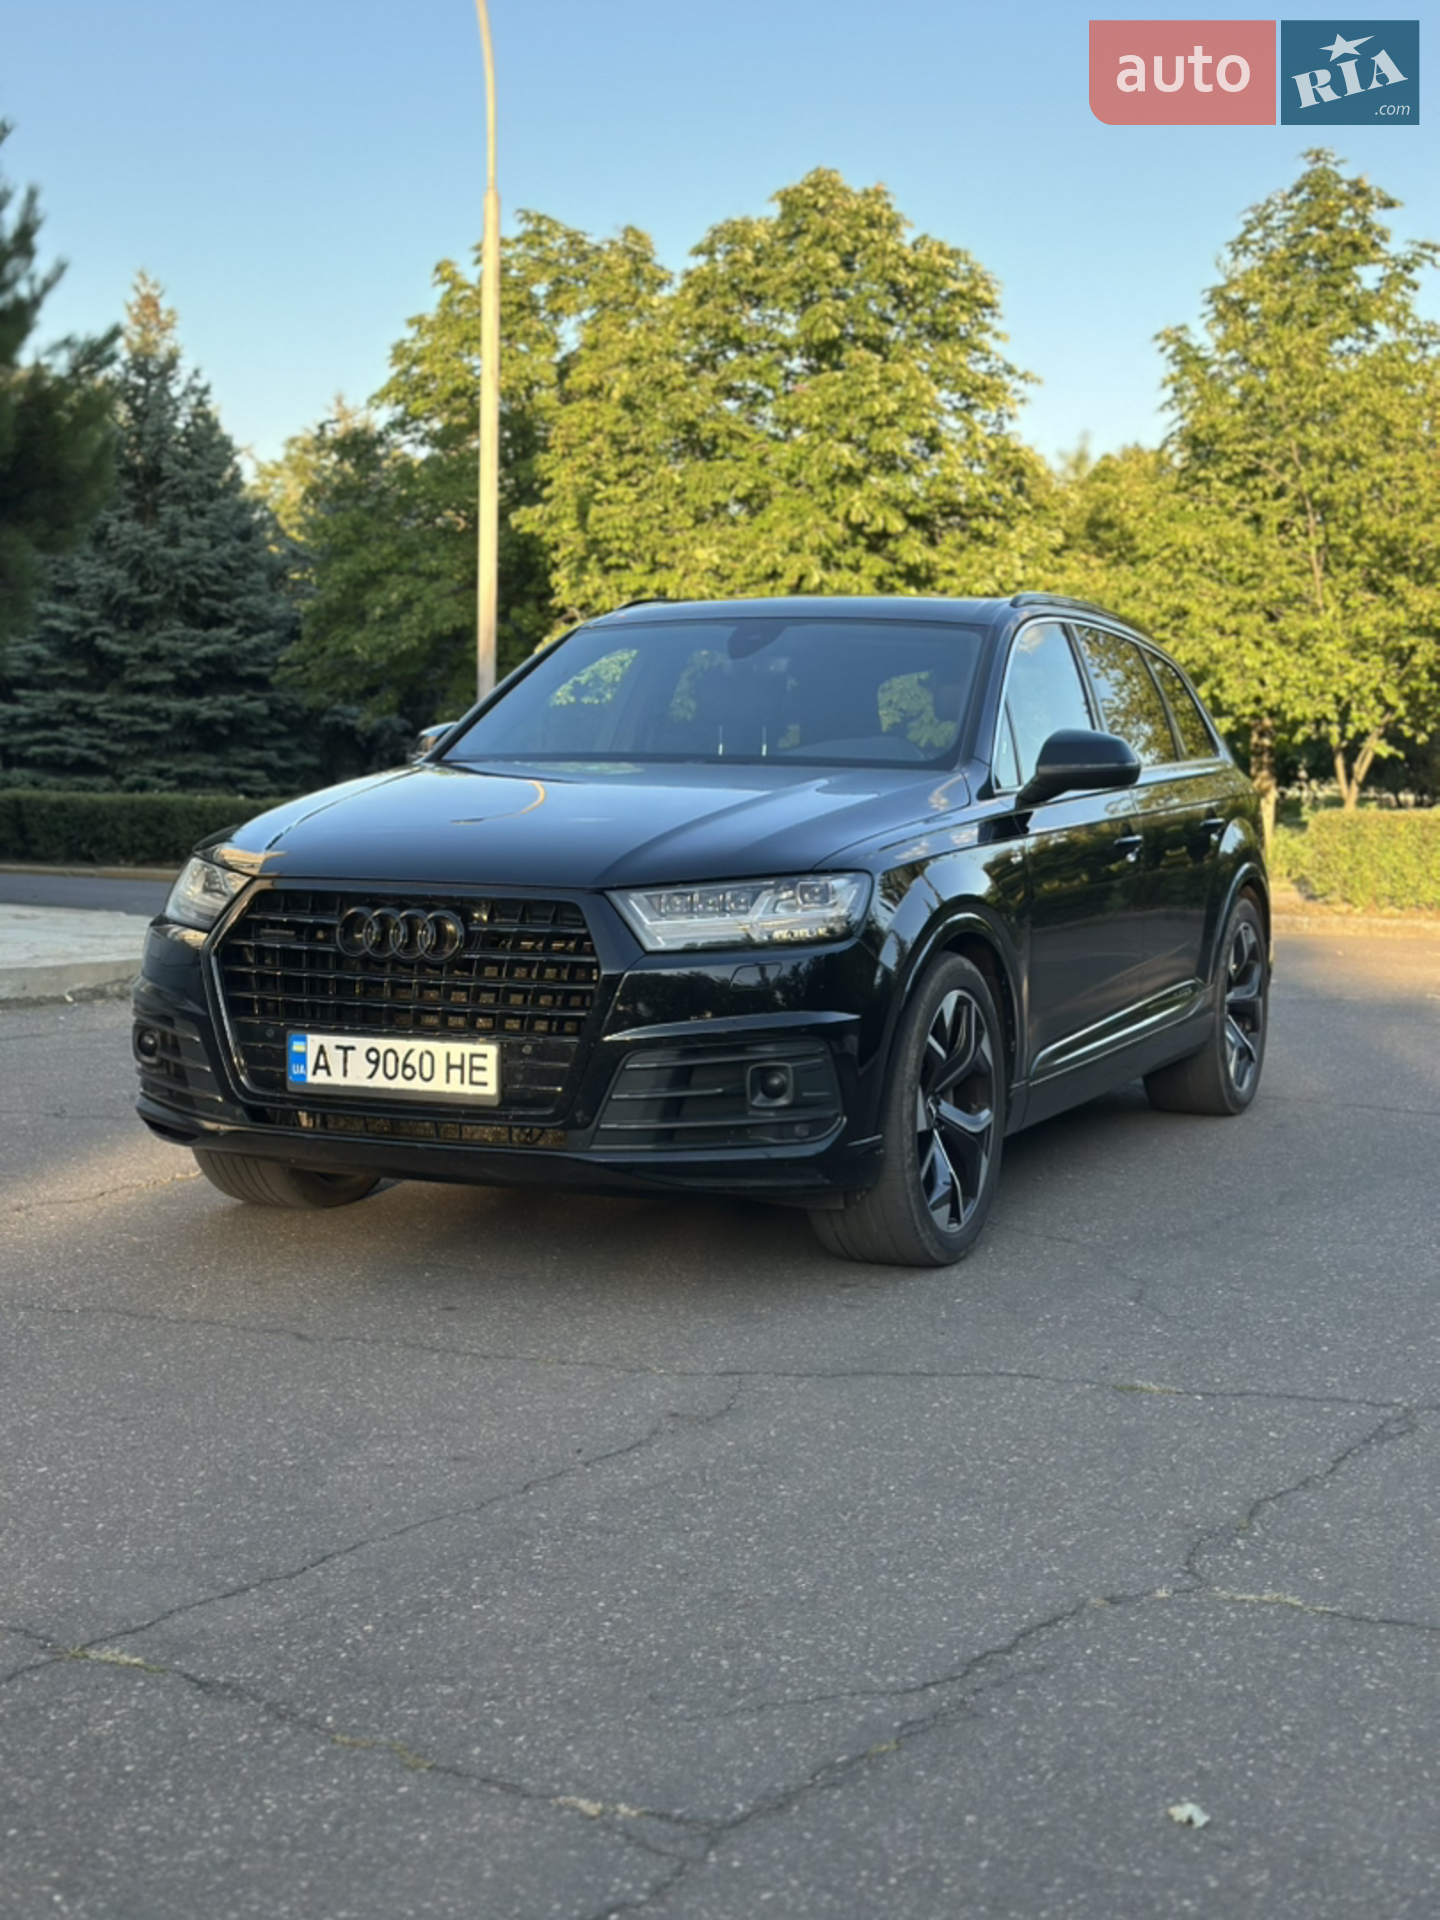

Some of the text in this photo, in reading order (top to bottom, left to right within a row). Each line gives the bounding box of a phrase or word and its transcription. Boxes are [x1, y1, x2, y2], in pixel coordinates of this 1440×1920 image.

[312, 1044, 488, 1086] AT 9060 HE
